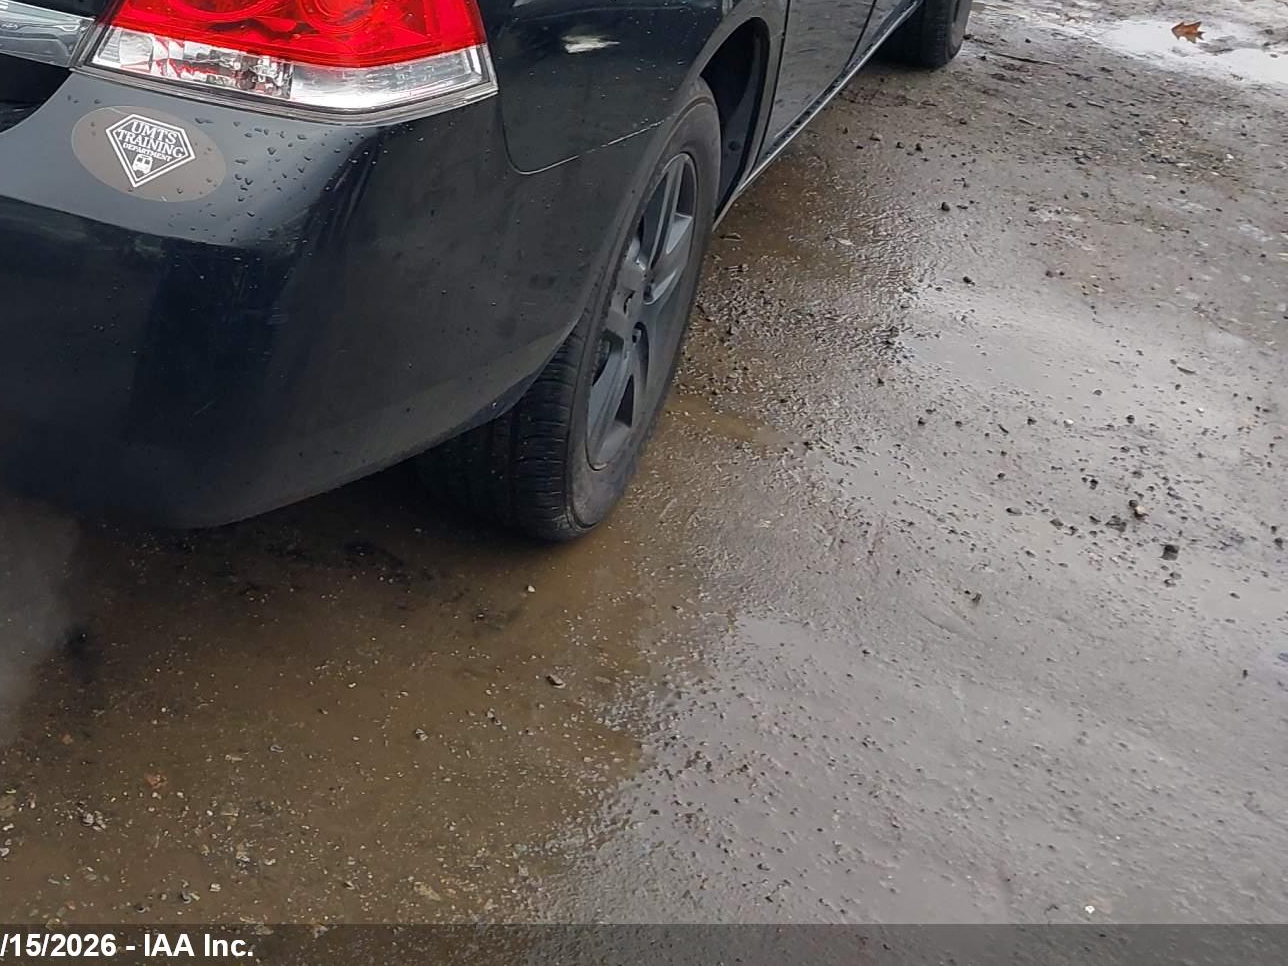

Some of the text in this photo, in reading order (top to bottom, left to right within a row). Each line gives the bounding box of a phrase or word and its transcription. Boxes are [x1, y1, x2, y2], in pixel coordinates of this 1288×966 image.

[117, 128, 184, 158] TRAINING
[131, 121, 178, 145] UMTS
[123, 142, 173, 162] DEPARTMENT
